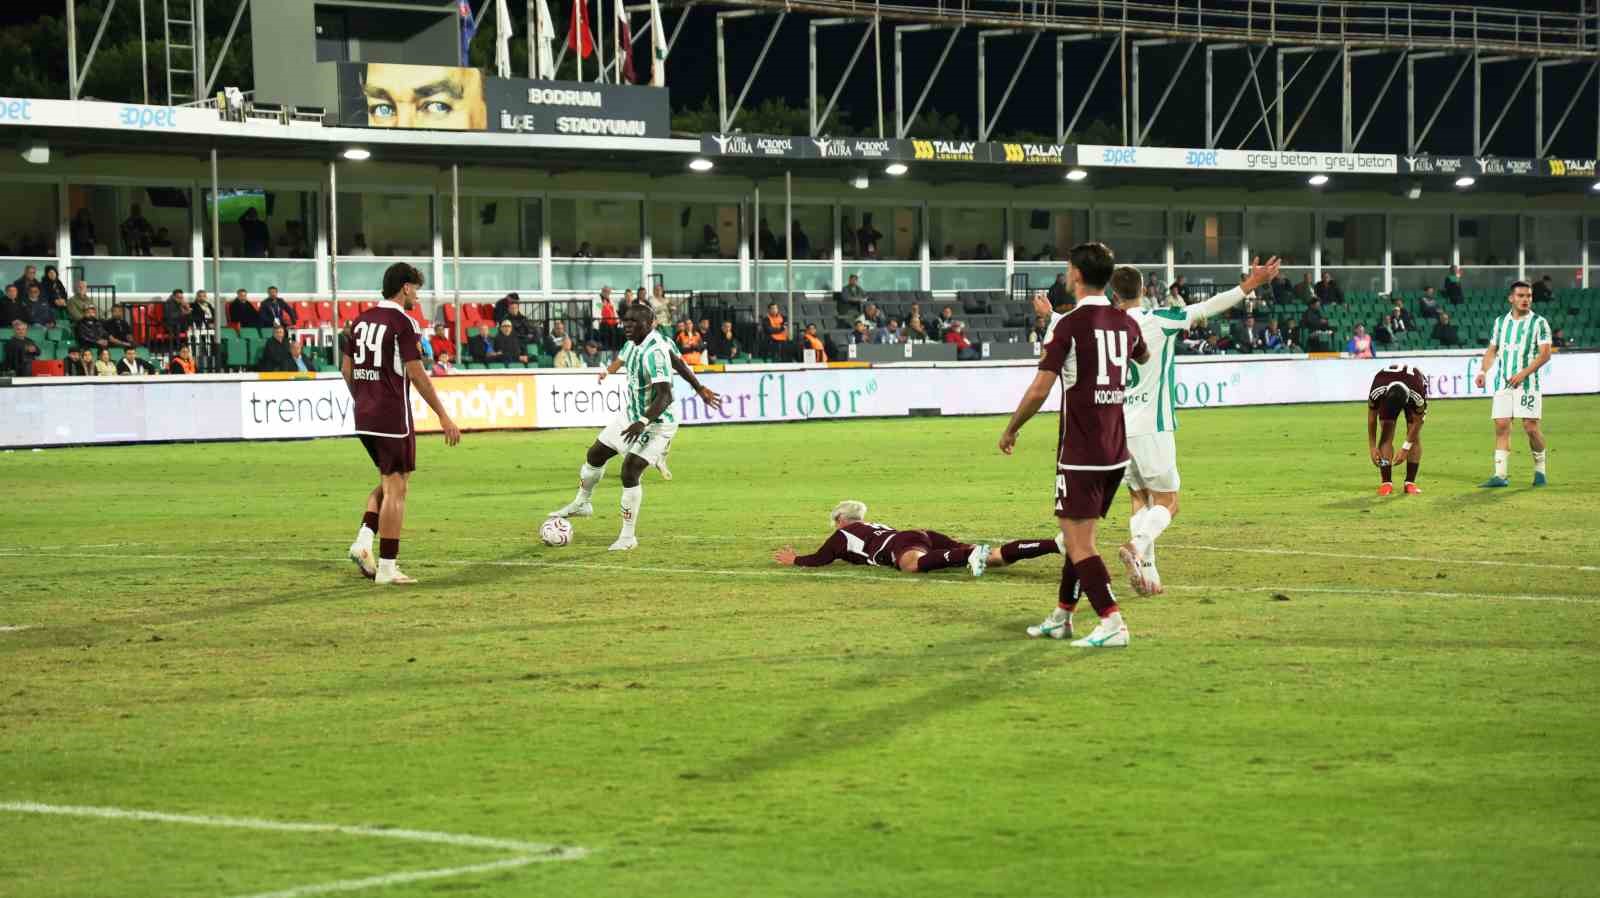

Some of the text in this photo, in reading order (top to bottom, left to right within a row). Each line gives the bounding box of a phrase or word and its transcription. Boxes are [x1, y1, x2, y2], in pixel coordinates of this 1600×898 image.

[528, 88, 602, 107] BODRUM
[556, 116, 646, 136] STADYUMU
[728, 141, 753, 154] AURA
[828, 144, 852, 157] AURA
[933, 141, 976, 154] TALAY
[1023, 144, 1064, 156] TALAY
[1247, 152, 1317, 168] grey beton
[1324, 155, 1393, 170] grey beton
[1564, 159, 1597, 170] TALAY
[353, 321, 388, 367] 34
[1094, 329, 1128, 386] 14
[551, 384, 628, 414] trend
[681, 373, 862, 421] nterfloor
[1520, 394, 1536, 408] 82
[250, 390, 350, 427] trendy
